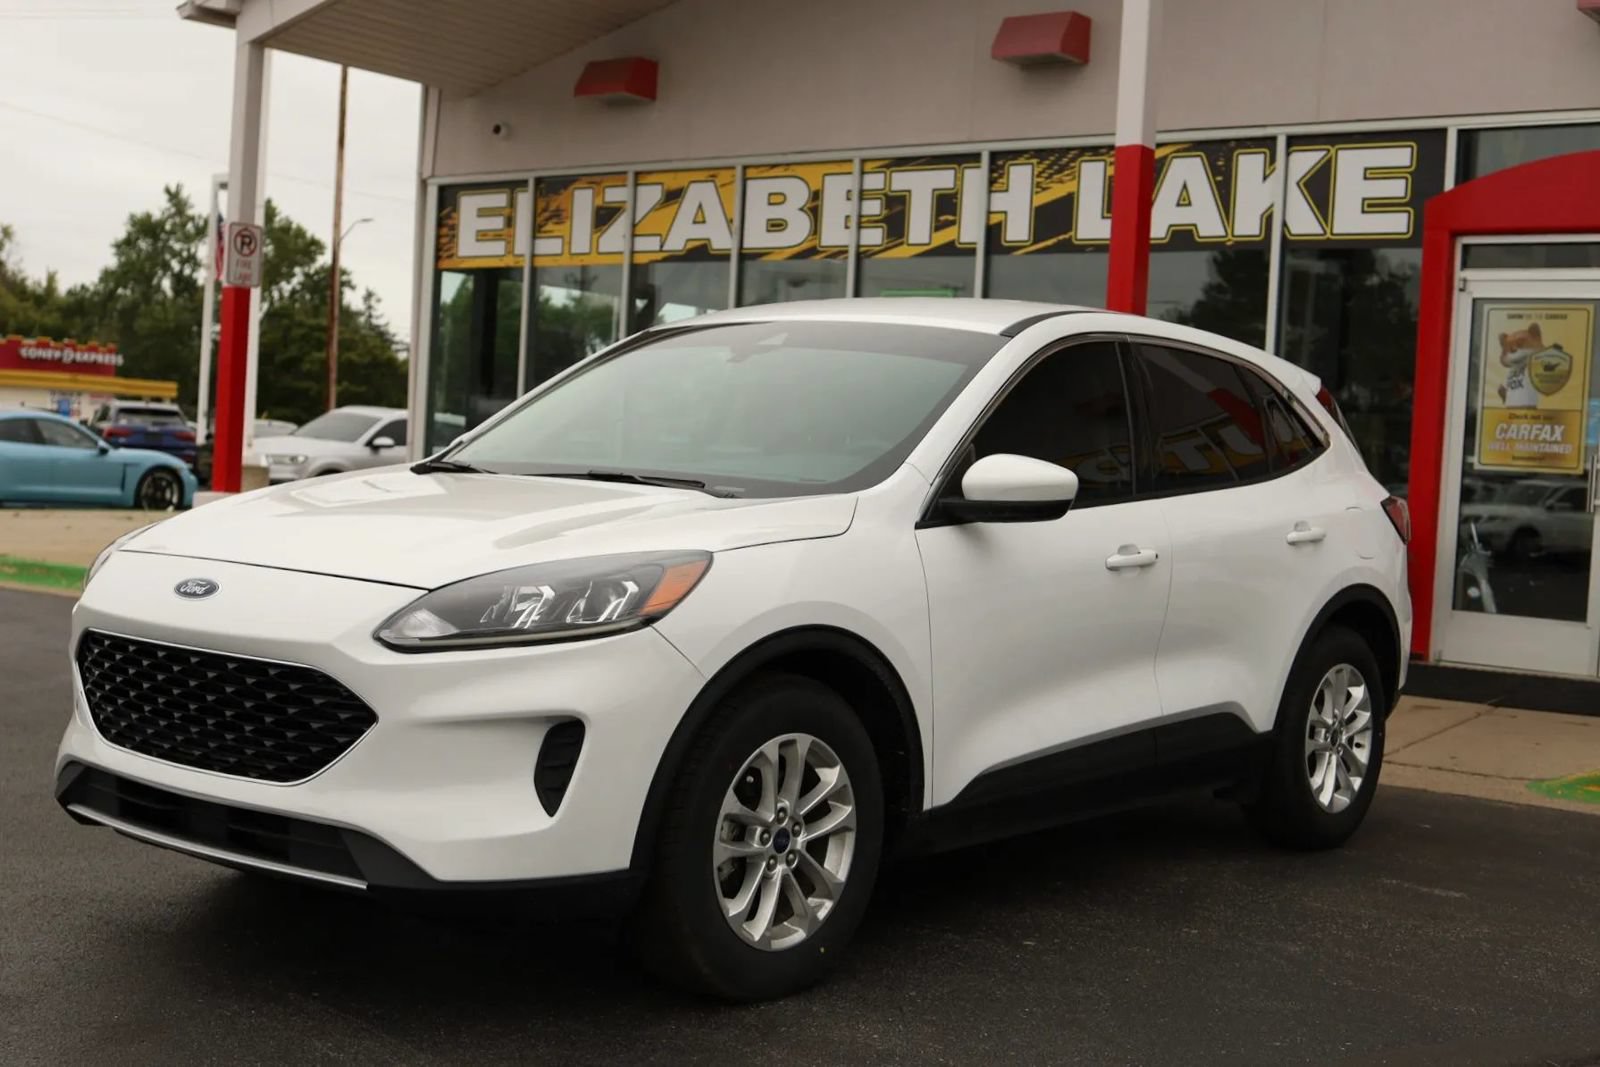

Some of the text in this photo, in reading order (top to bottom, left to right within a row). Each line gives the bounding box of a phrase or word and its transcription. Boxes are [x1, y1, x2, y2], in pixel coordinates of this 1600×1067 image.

[457, 142, 1417, 258] ELIZABETH LAKE
[1495, 423, 1565, 441] CARFAX
[178, 579, 213, 596] Ford
